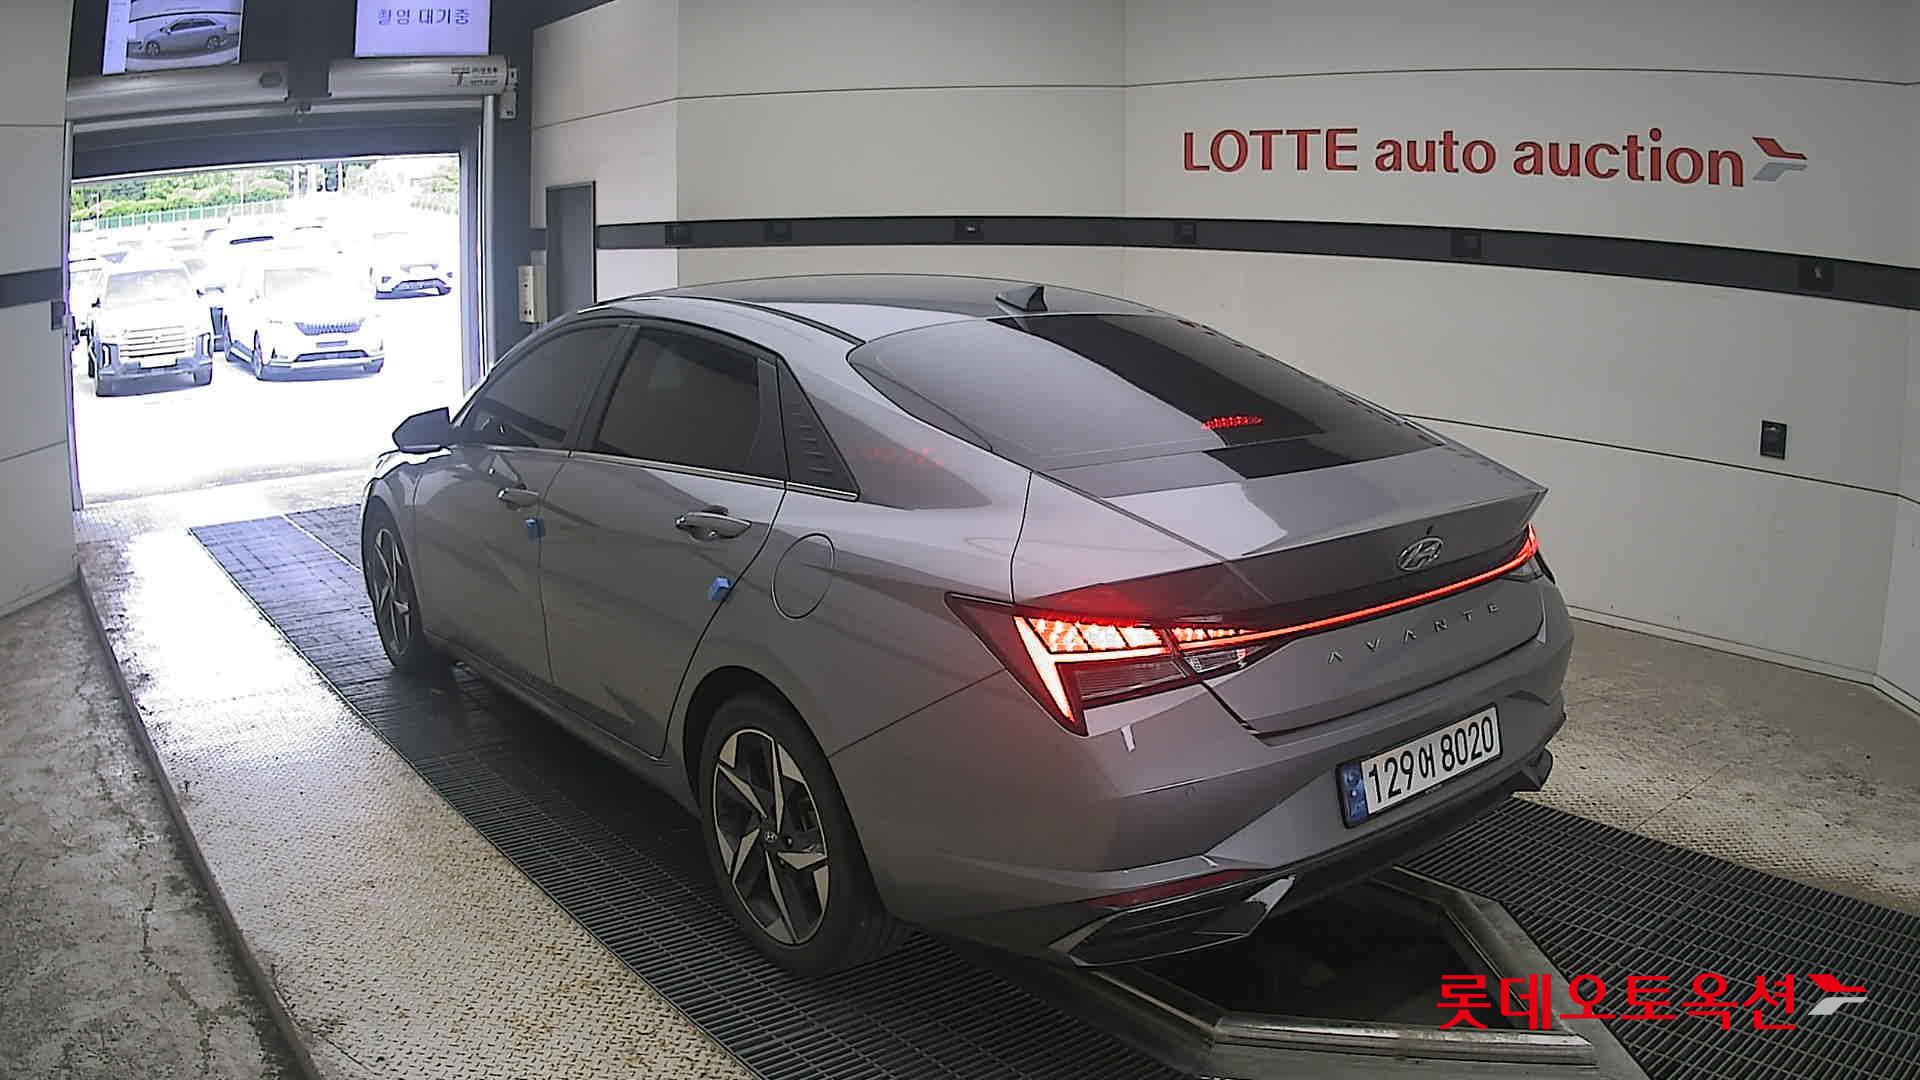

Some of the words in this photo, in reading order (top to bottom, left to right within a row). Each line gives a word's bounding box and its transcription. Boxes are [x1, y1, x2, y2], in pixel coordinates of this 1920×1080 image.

[378, 8, 411, 25] 촬영
[418, 7, 471, 25] 대기중
[1183, 128, 1359, 172] LOTTE
[1375, 129, 1497, 175] auto
[1513, 127, 1745, 187] auction
[1327, 602, 1500, 665] AVANTE
[1368, 743, 1437, 804] 129어
[1440, 715, 1495, 773] 8020
